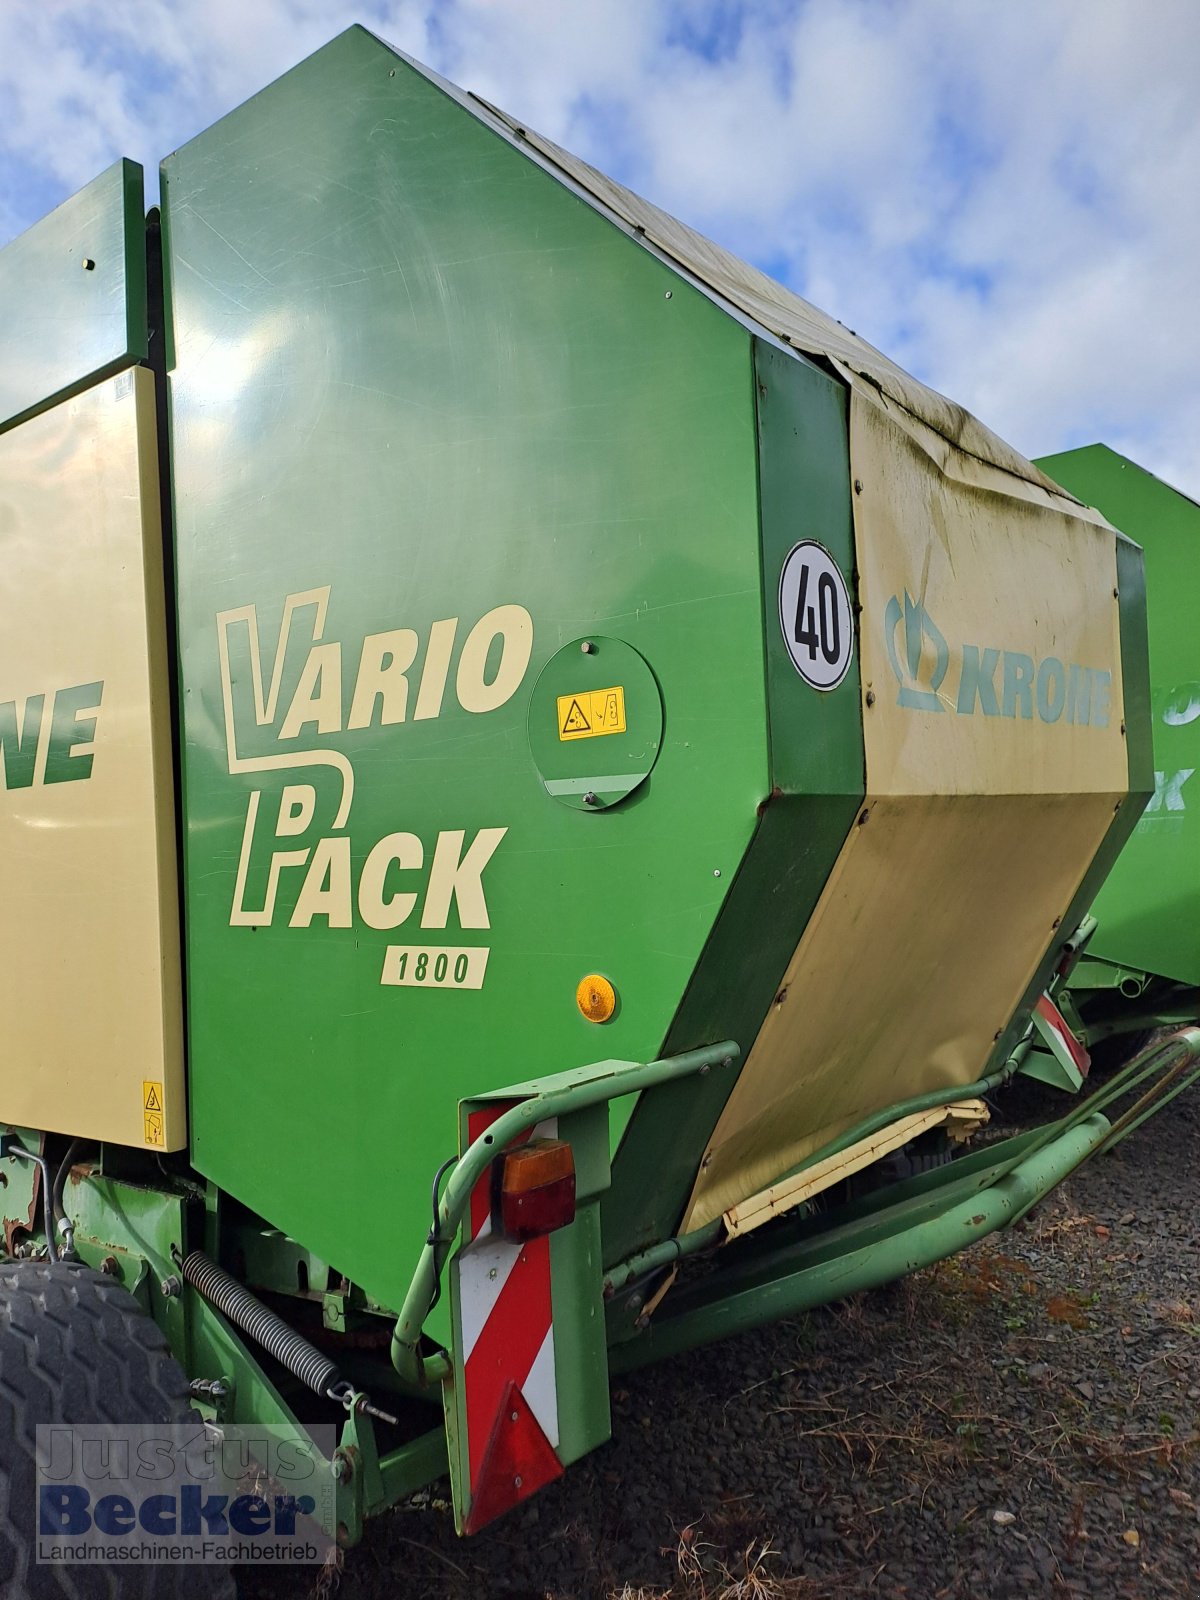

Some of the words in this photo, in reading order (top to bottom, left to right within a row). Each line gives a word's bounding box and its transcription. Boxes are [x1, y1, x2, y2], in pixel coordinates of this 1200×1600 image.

[794, 564, 840, 665] 40
[216, 585, 534, 774] VARIO
[957, 644, 1112, 728] KRONE
[229, 750, 508, 930] PACK
[399, 952, 469, 984] 1800
